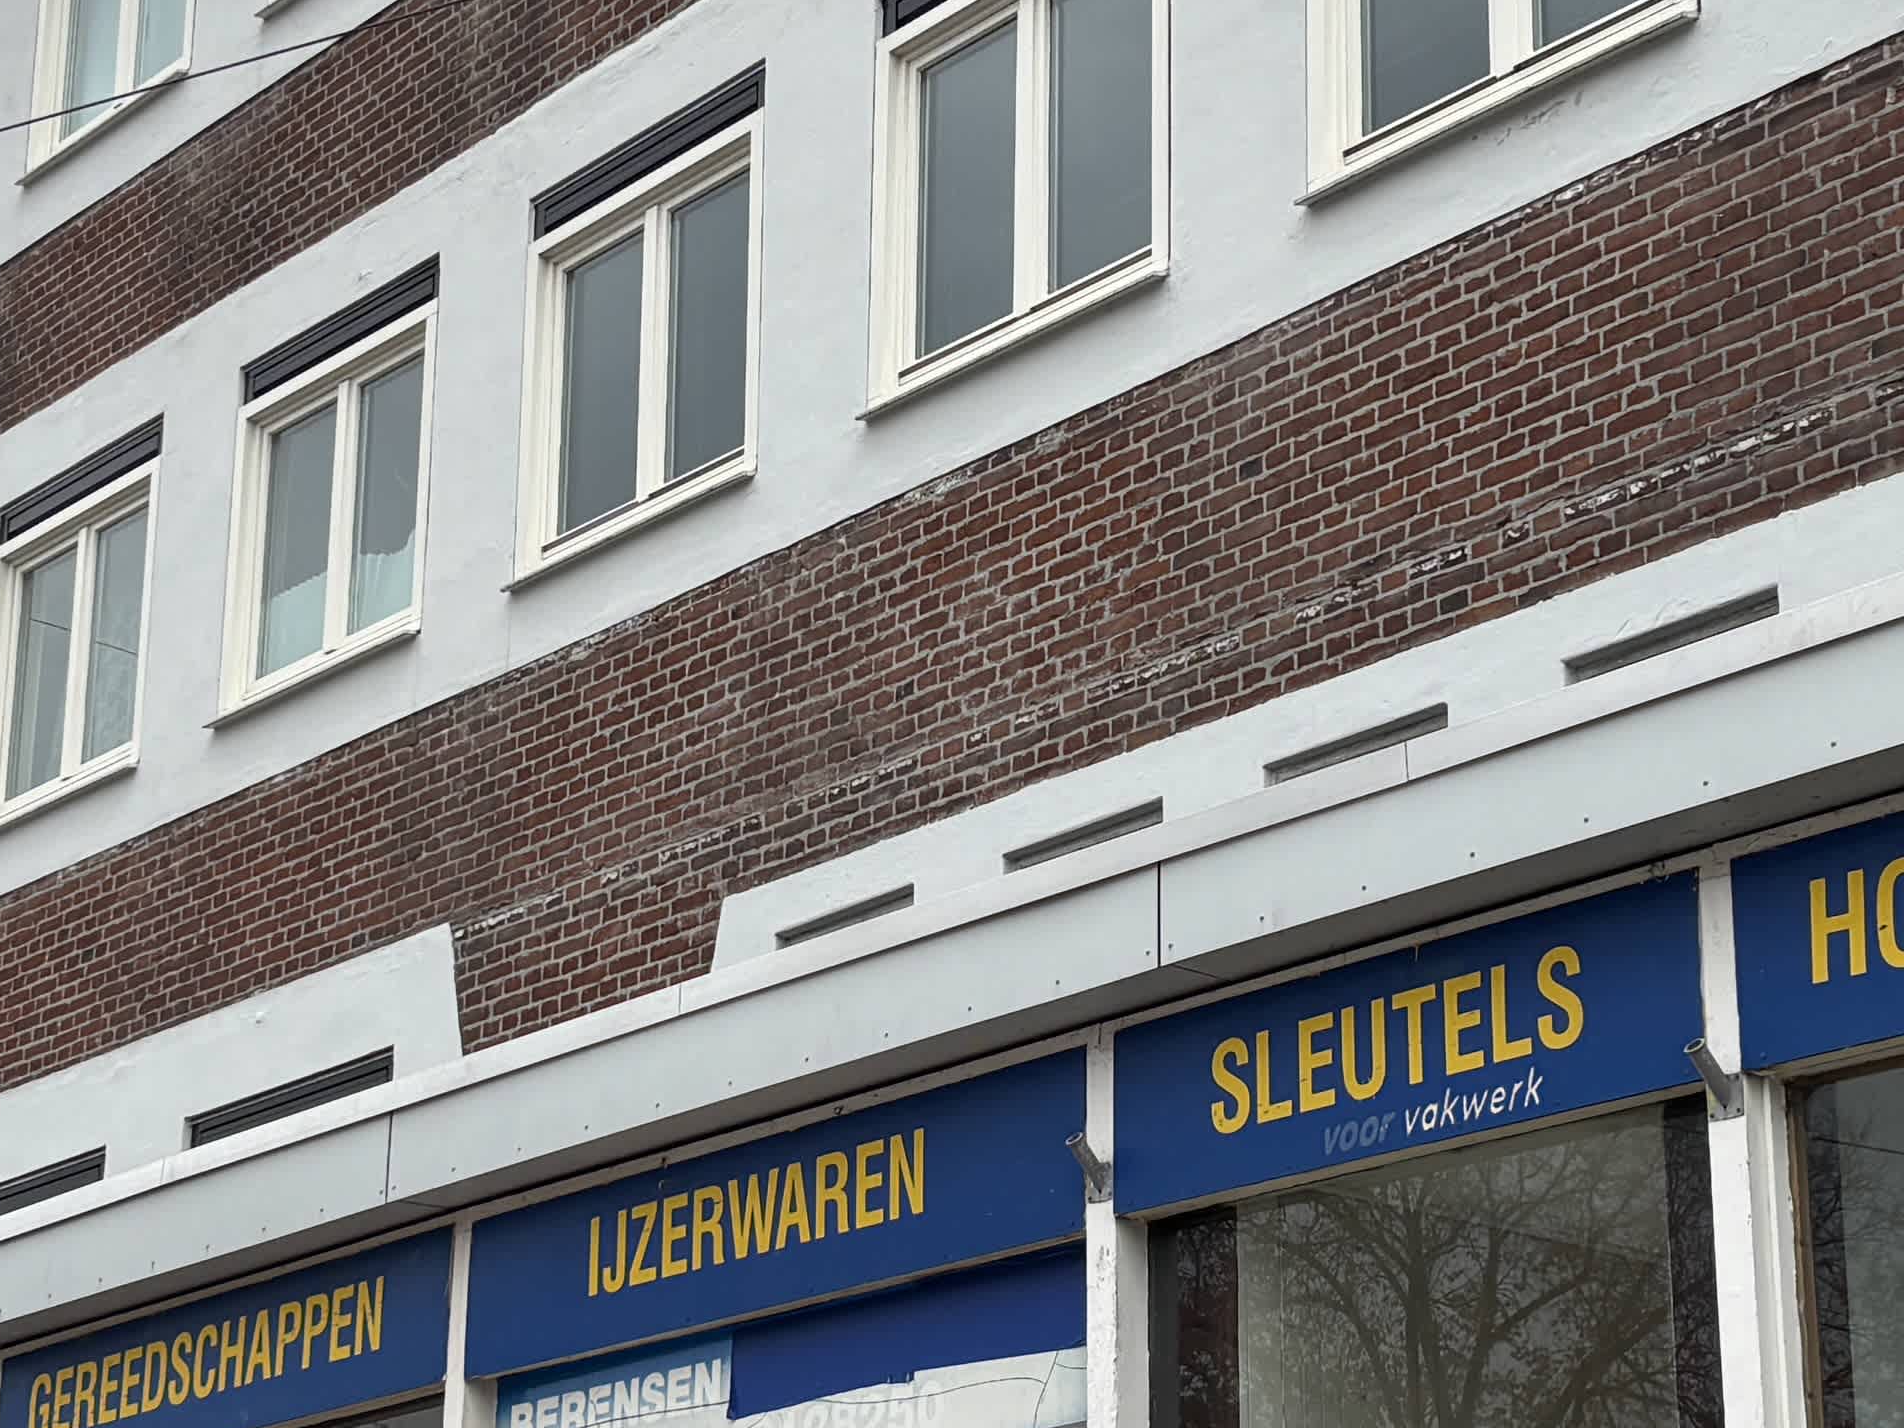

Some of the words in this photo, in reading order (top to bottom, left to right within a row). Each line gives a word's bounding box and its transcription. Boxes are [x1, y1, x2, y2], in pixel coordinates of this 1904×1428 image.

[1210, 945, 1586, 1135] SLEUTELS
[1322, 1112, 1395, 1157] voor
[1404, 1067, 1545, 1137] vakwerk
[588, 1127, 926, 1298] IJZERWAREN
